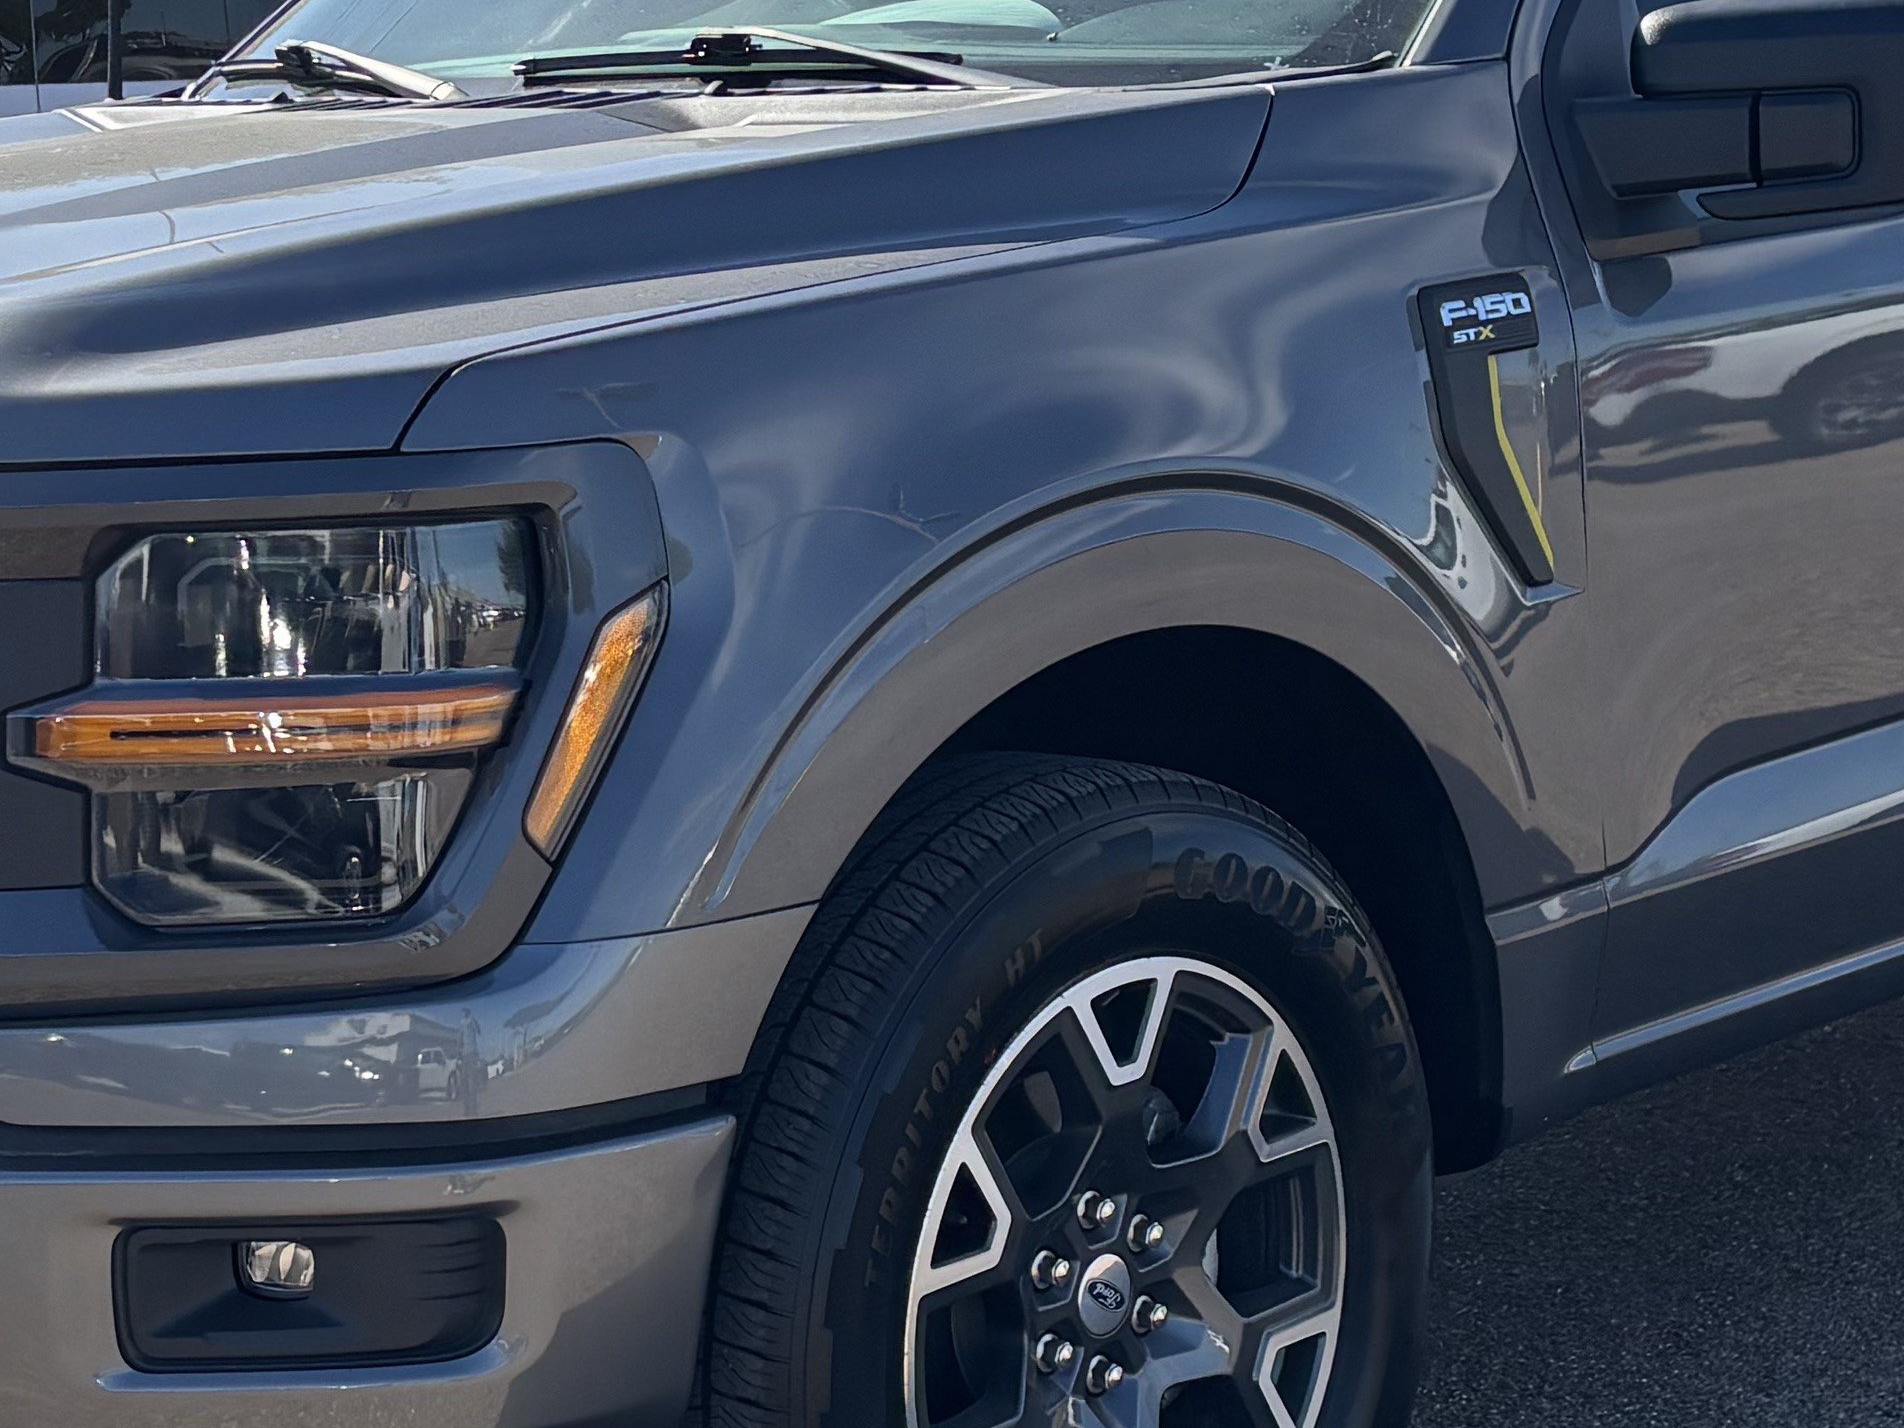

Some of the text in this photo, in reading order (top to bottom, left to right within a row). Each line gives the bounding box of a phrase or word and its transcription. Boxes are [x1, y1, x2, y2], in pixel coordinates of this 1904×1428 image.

[1440, 291, 1532, 327] F-150
[1453, 324, 1496, 345] STX
[1004, 929, 1044, 987] HT
[1092, 1282, 1122, 1309] Ford
